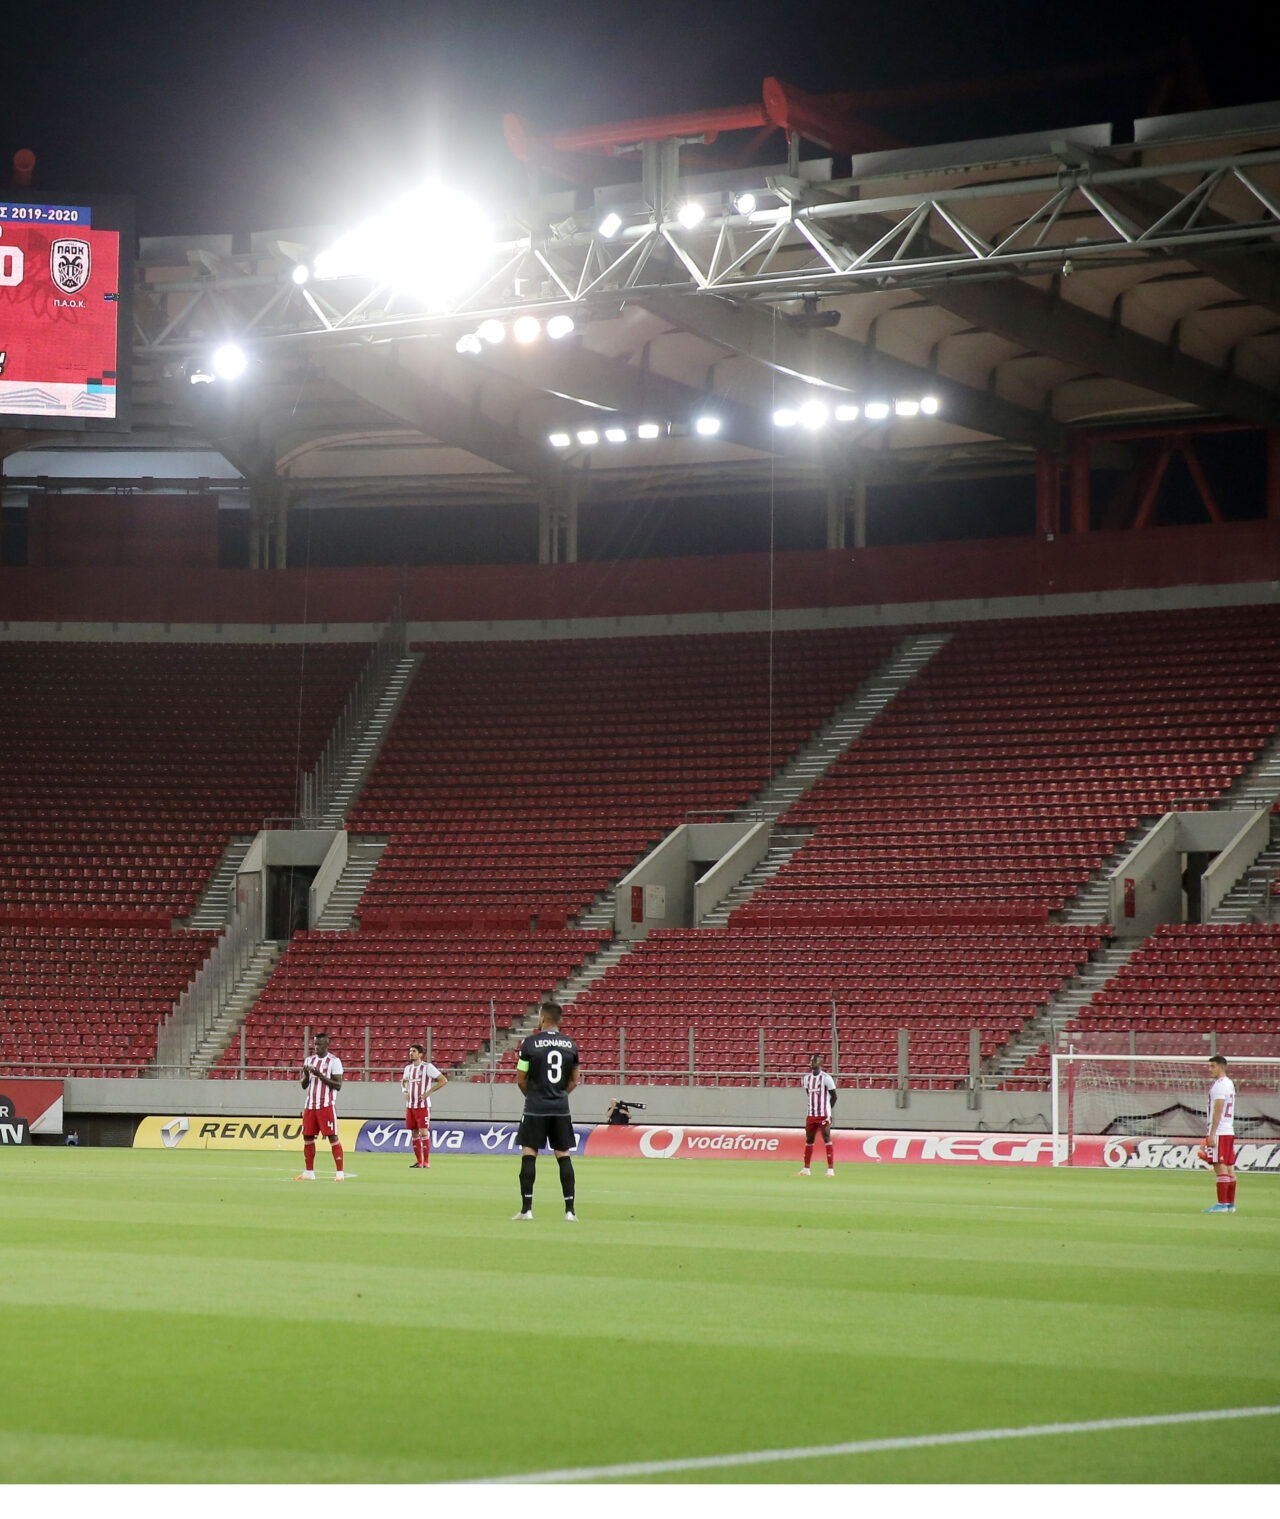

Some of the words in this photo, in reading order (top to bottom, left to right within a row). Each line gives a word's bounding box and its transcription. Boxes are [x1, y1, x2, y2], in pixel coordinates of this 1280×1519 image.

[12, 208, 79, 221] 2019-2020
[534, 1039, 573, 1048] LEONARDO
[547, 1050, 562, 1083] 3
[199, 1123, 328, 1140] RENAU
[393, 1129, 465, 1149] nva
[687, 1133, 780, 1151] vodafone
